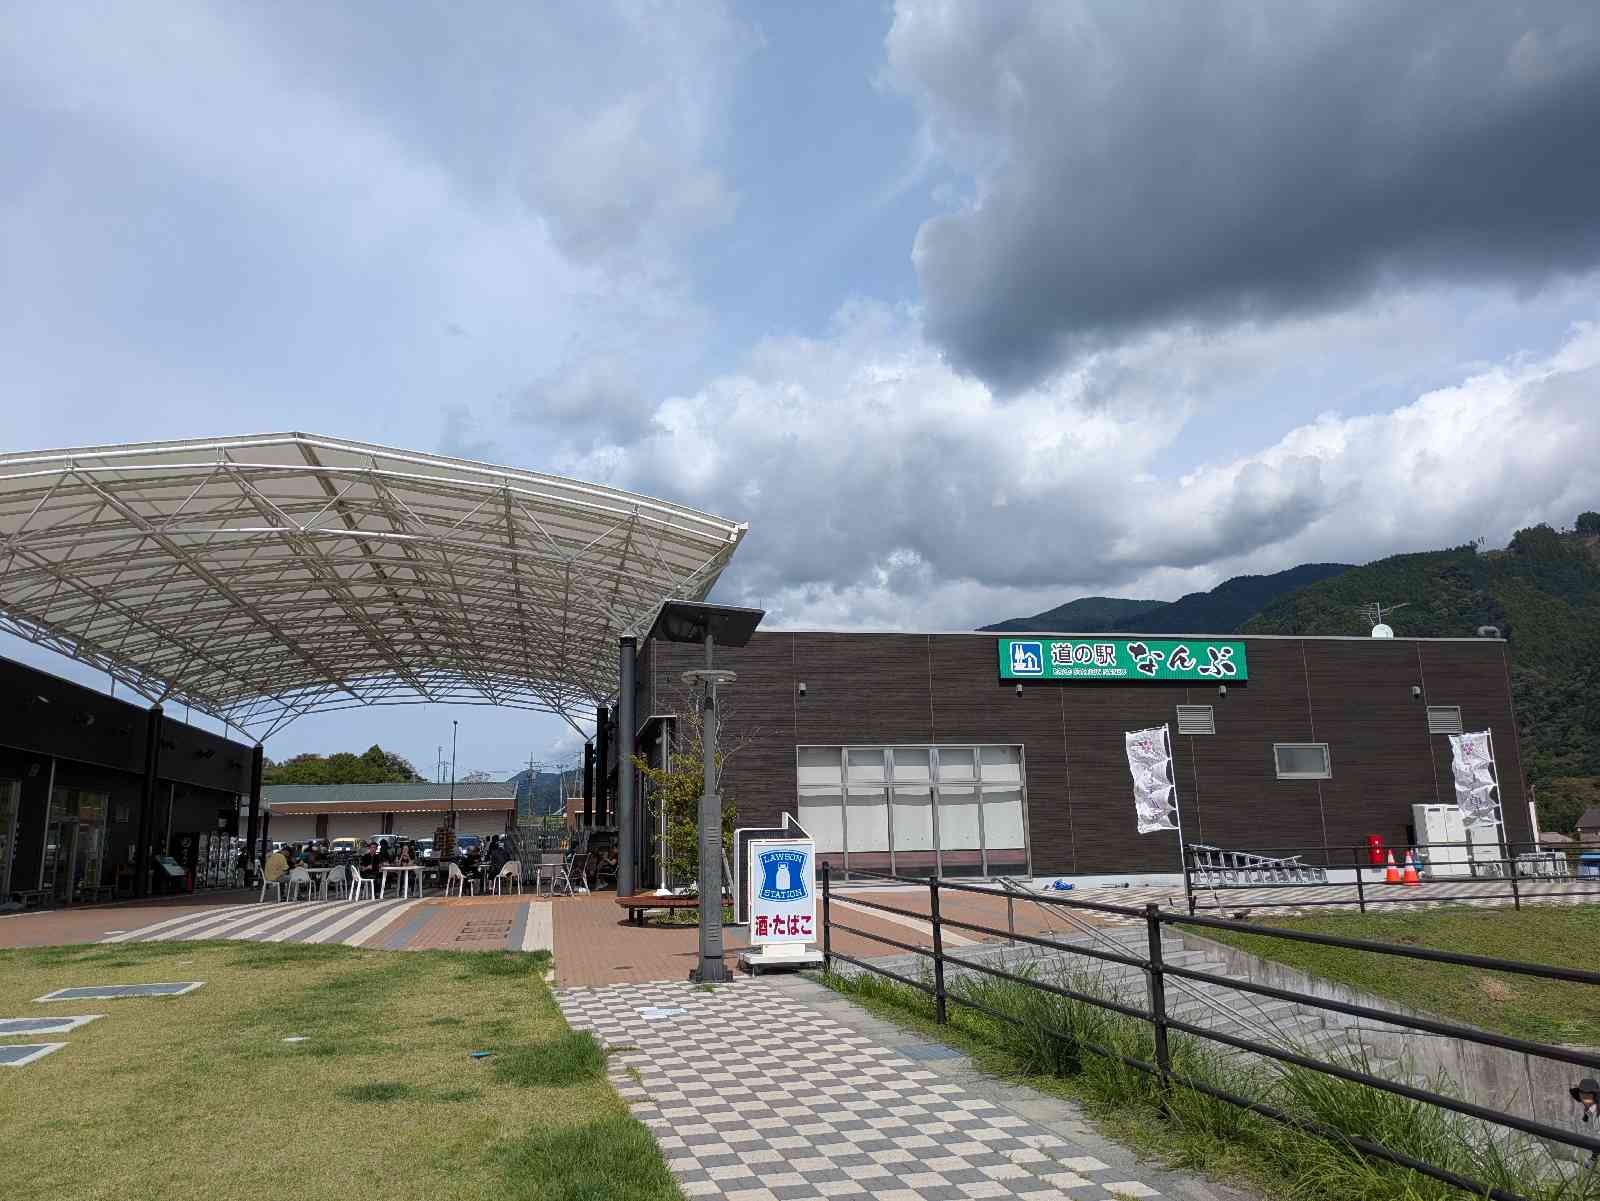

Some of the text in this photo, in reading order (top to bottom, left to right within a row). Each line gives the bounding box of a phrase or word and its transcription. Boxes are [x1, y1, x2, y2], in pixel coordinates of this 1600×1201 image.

[1051, 642, 1237, 678] 道の駅 なんぶ
[763, 852, 803, 863] LAWSON
[763, 888, 802, 899] STATION
